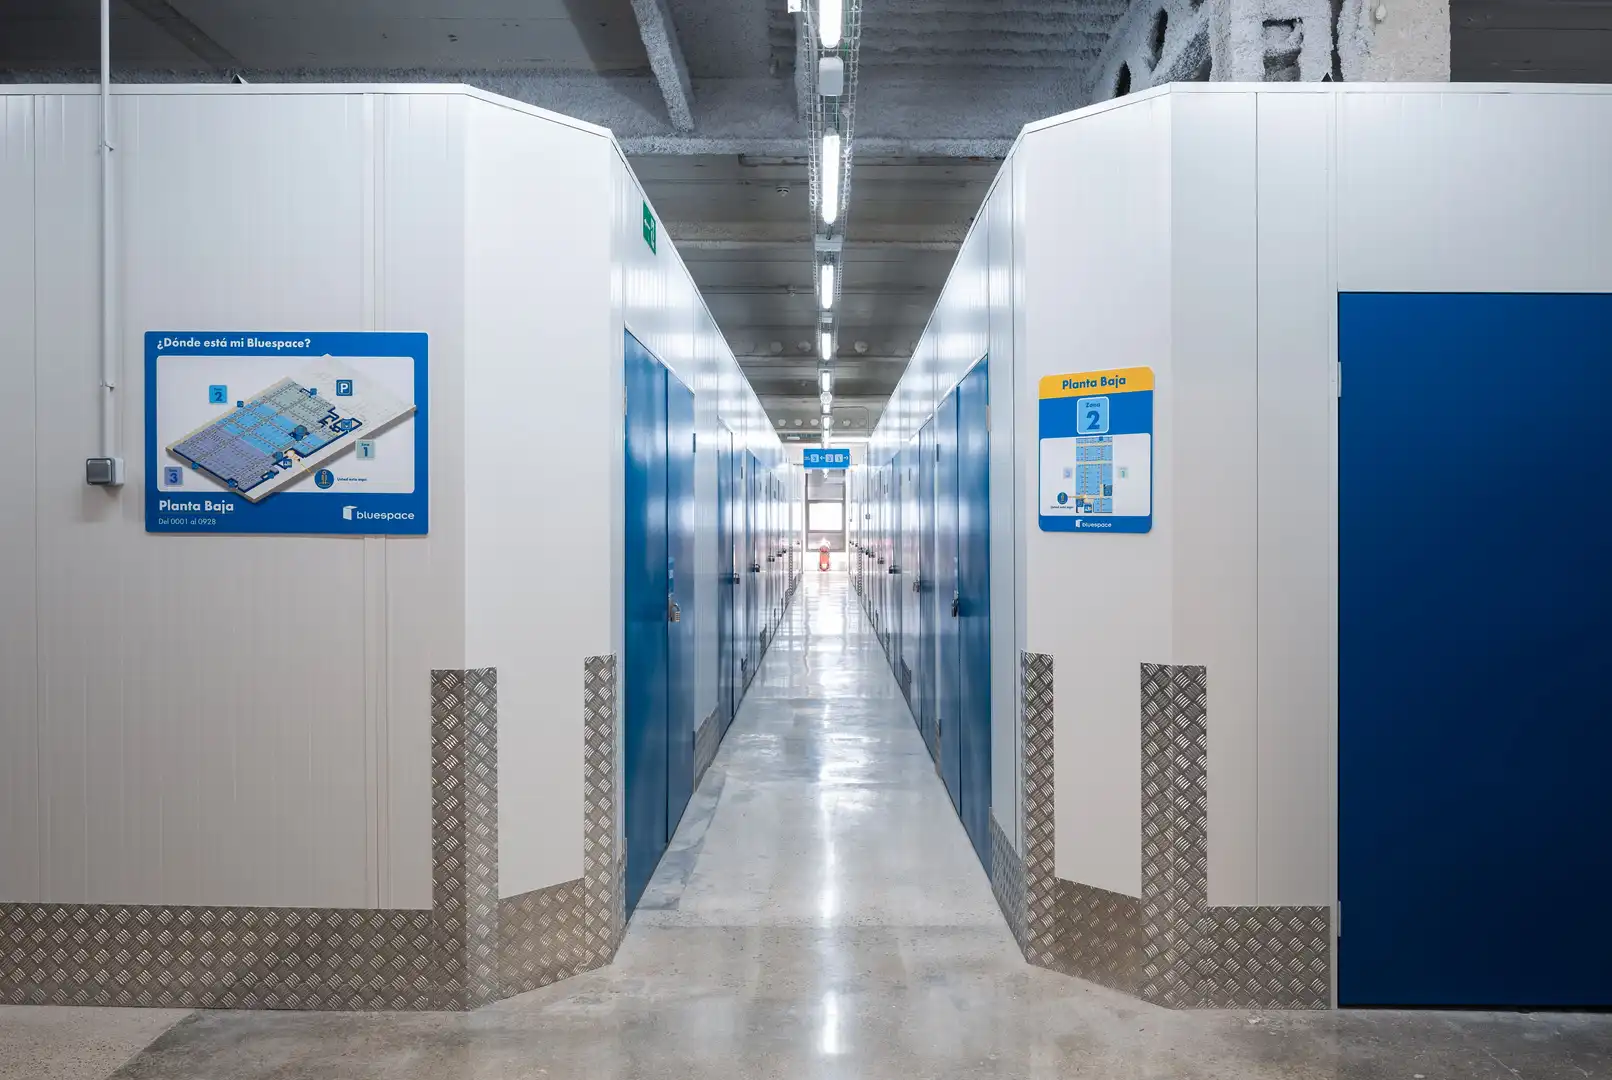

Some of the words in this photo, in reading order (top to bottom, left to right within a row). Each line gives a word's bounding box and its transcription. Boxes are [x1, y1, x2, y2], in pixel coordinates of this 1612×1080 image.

[157, 337, 201, 350] ¿Dónde
[203, 337, 228, 348] está
[230, 338, 244, 348] mi
[247, 337, 312, 350] Bluespace?
[1062, 378, 1097, 390] Planta
[1100, 375, 1126, 389] Baja
[214, 391, 223, 402] 2
[1086, 410, 1101, 430] 2
[363, 446, 368, 457] 1
[169, 472, 178, 484] 3
[159, 499, 201, 511] Planta
[204, 499, 234, 515] Baja
[158, 517, 170, 525] Del
[356, 510, 415, 521] bluespace
[1081, 521, 1112, 529] bluespace
